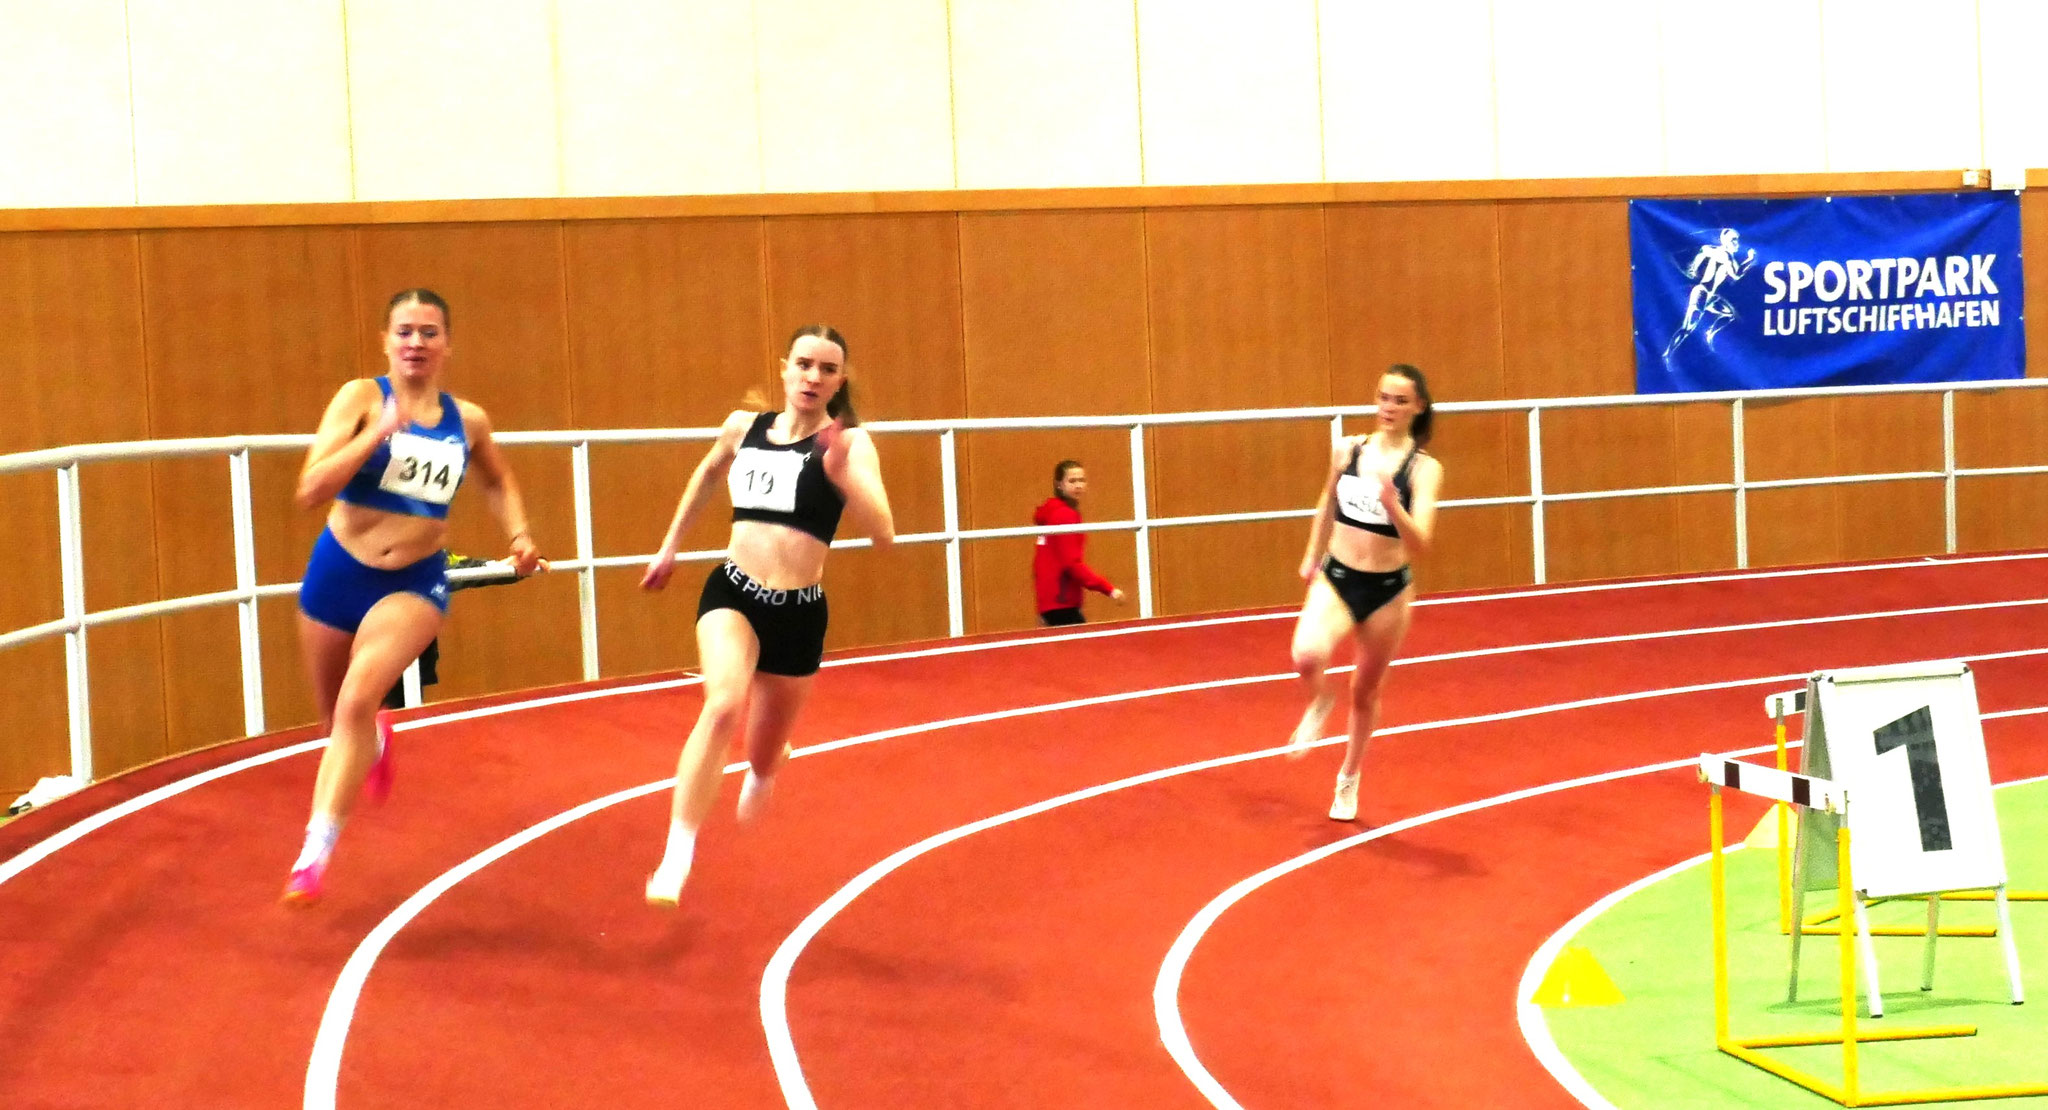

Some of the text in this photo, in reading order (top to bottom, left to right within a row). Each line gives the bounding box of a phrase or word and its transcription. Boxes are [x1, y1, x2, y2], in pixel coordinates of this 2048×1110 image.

[1763, 254, 1999, 304] SPORTPARK
[1763, 300, 2000, 336] LUFTSCHIFFHAFEN
[399, 456, 450, 490] 314
[745, 469, 774, 495] 19
[742, 578, 787, 605] PRO
[1873, 705, 1953, 852] 1
